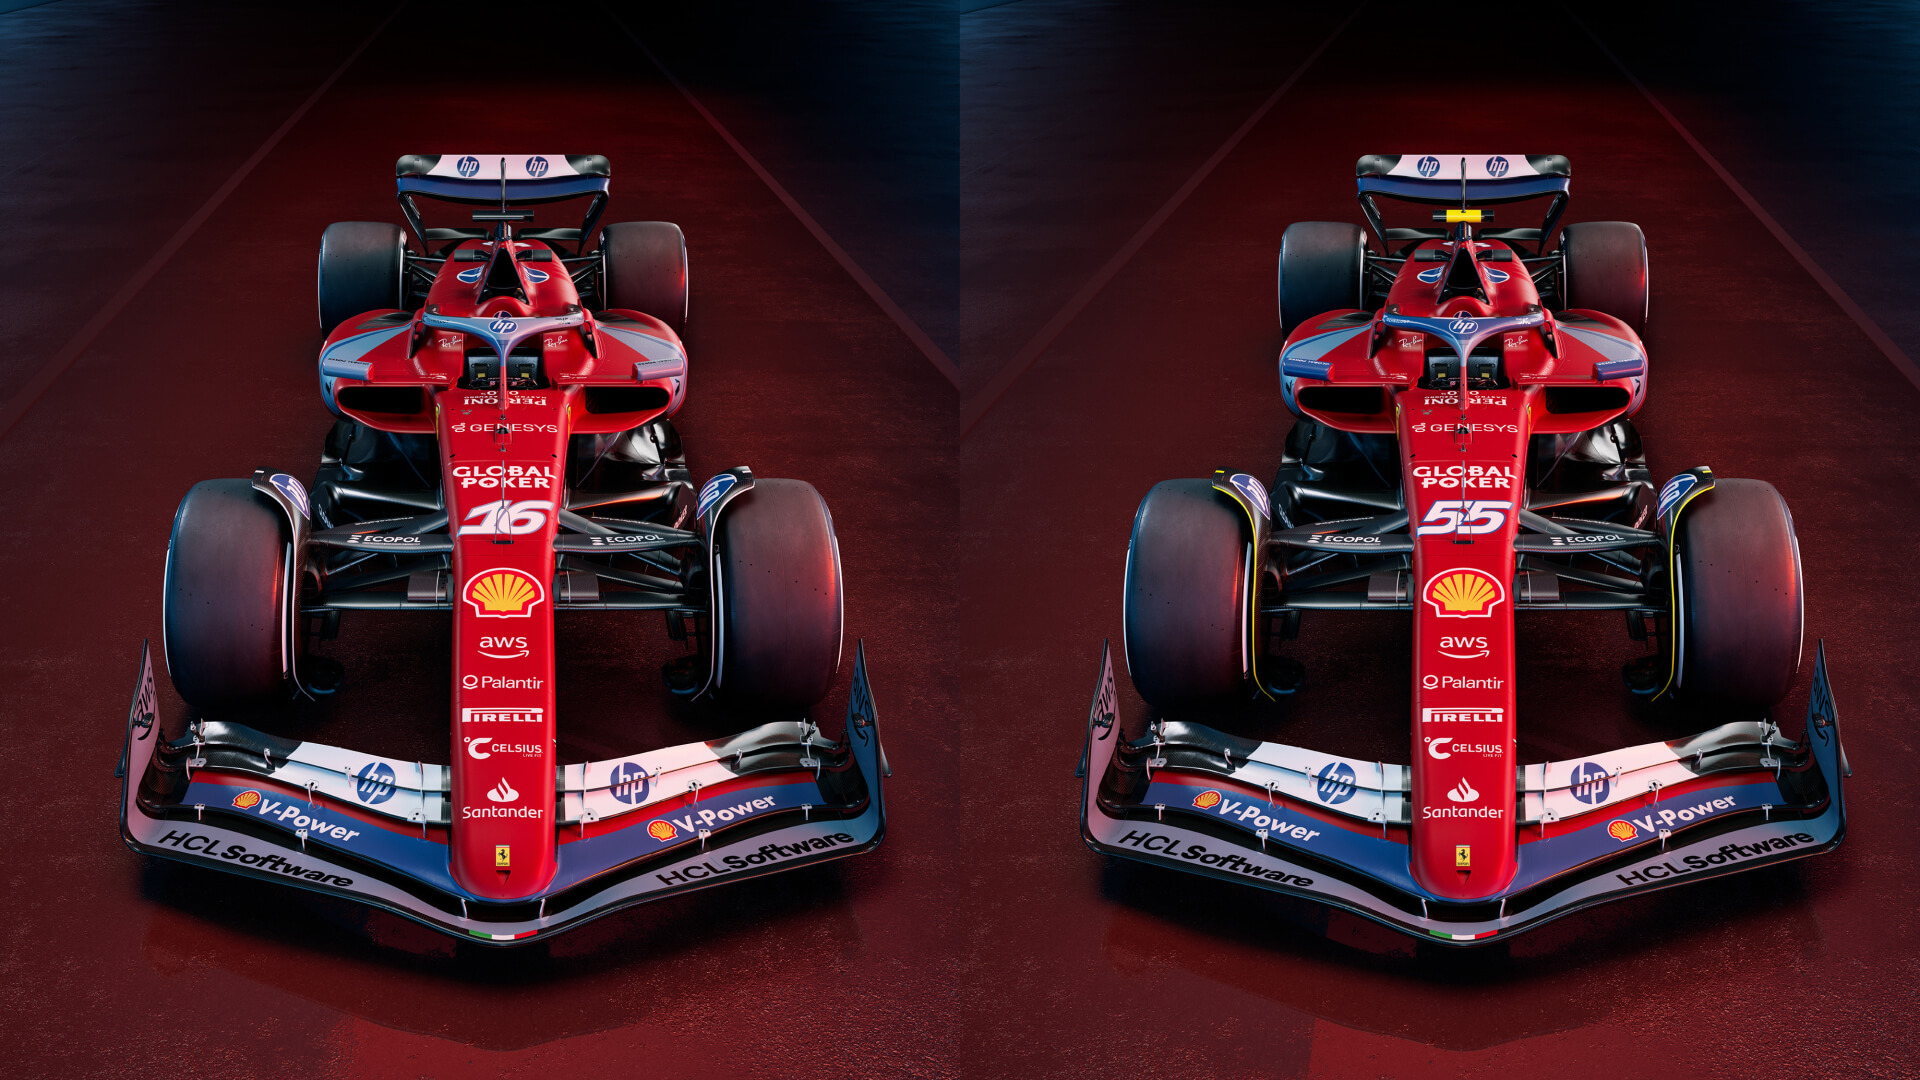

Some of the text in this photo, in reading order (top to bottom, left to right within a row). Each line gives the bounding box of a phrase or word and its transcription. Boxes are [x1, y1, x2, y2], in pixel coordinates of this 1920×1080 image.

[459, 156, 478, 178] hp
[528, 156, 547, 178] hp
[1419, 156, 1438, 178] hp
[1488, 156, 1507, 178] hp
[492, 319, 515, 334] hp
[1452, 319, 1475, 334] hp
[464, 397, 547, 406] PERONI
[1424, 397, 1507, 406] PERONI
[470, 423, 558, 433] GENESYS
[1430, 423, 1518, 433] GENESYS
[452, 465, 557, 479] GLOBAL
[1412, 465, 1517, 479] GLOBAL
[461, 477, 550, 489] POKER
[1421, 477, 1510, 489] POKER
[456, 499, 554, 538] 16
[1416, 500, 1513, 538] 55
[363, 535, 421, 543] ECOPOL
[605, 534, 664, 543] ECOPOL
[1323, 535, 1381, 543] ECOPOL
[1565, 534, 1624, 543] ECOPOL
[479, 636, 528, 649] aws
[1439, 636, 1488, 649] aws
[481, 675, 544, 690] Palantir
[1441, 675, 1504, 690] Palantir
[462, 707, 544, 723] PIRELLI
[1422, 707, 1504, 723] PIRELLI
[491, 743, 543, 754] CELSIUS
[1451, 743, 1503, 754] CELSIUS
[358, 762, 395, 805] hp
[614, 761, 647, 804] hp
[1318, 762, 1355, 805] hp
[1574, 761, 1607, 804] hp
[258, 796, 361, 843] V-Power
[462, 805, 544, 819] Santander
[672, 793, 778, 834] V-Power
[1218, 796, 1321, 843] V-Power
[1422, 805, 1504, 819] Santander
[1632, 793, 1738, 834] V-Power
[158, 829, 355, 889] HCLSoftware
[654, 830, 856, 887] HCLSoftware
[1118, 829, 1315, 889] HCLSoftware
[1614, 830, 1816, 887] HCLSoftware
